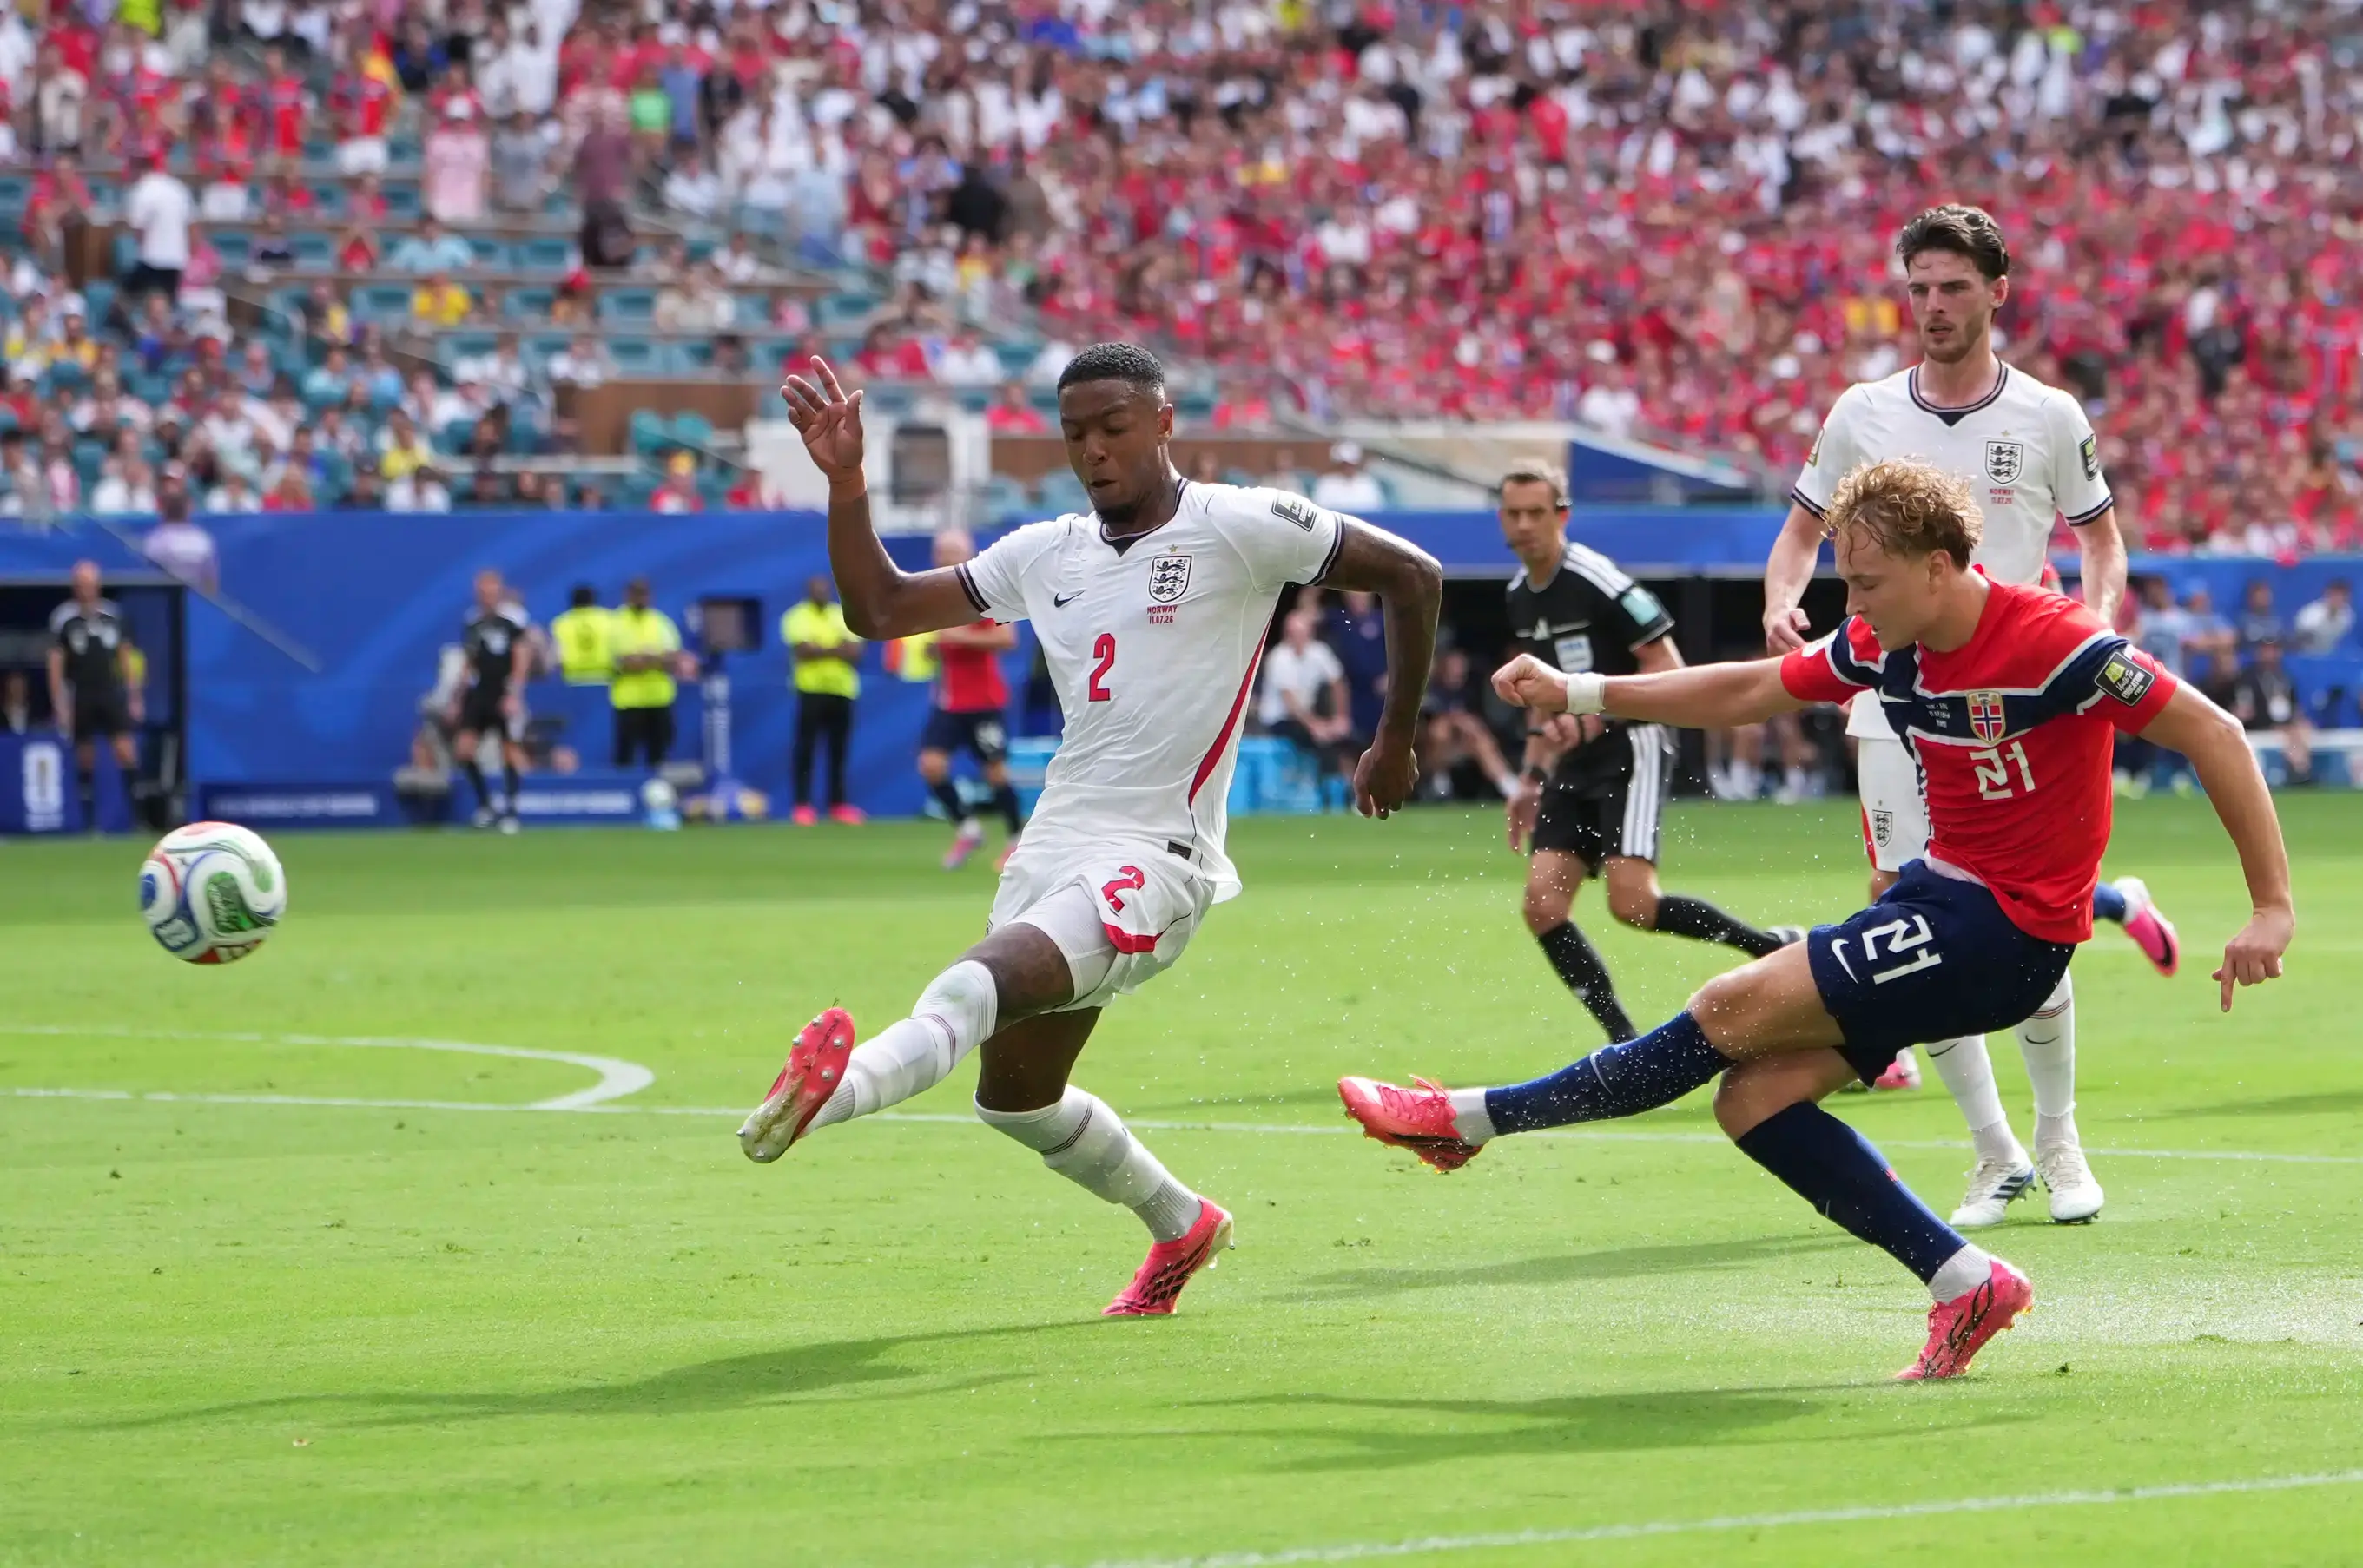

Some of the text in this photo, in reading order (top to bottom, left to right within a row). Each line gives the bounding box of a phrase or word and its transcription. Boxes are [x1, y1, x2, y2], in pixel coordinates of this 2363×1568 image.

[1146, 604, 1178, 615] NORWAY
[1149, 615, 1174, 624] 11.07.26
[1088, 632, 1116, 702] 2
[2121, 671, 2145, 699] EDUCATION
[1969, 741, 2036, 800] 21
[1101, 865, 1145, 914] 2
[1861, 914, 1943, 985] 21
